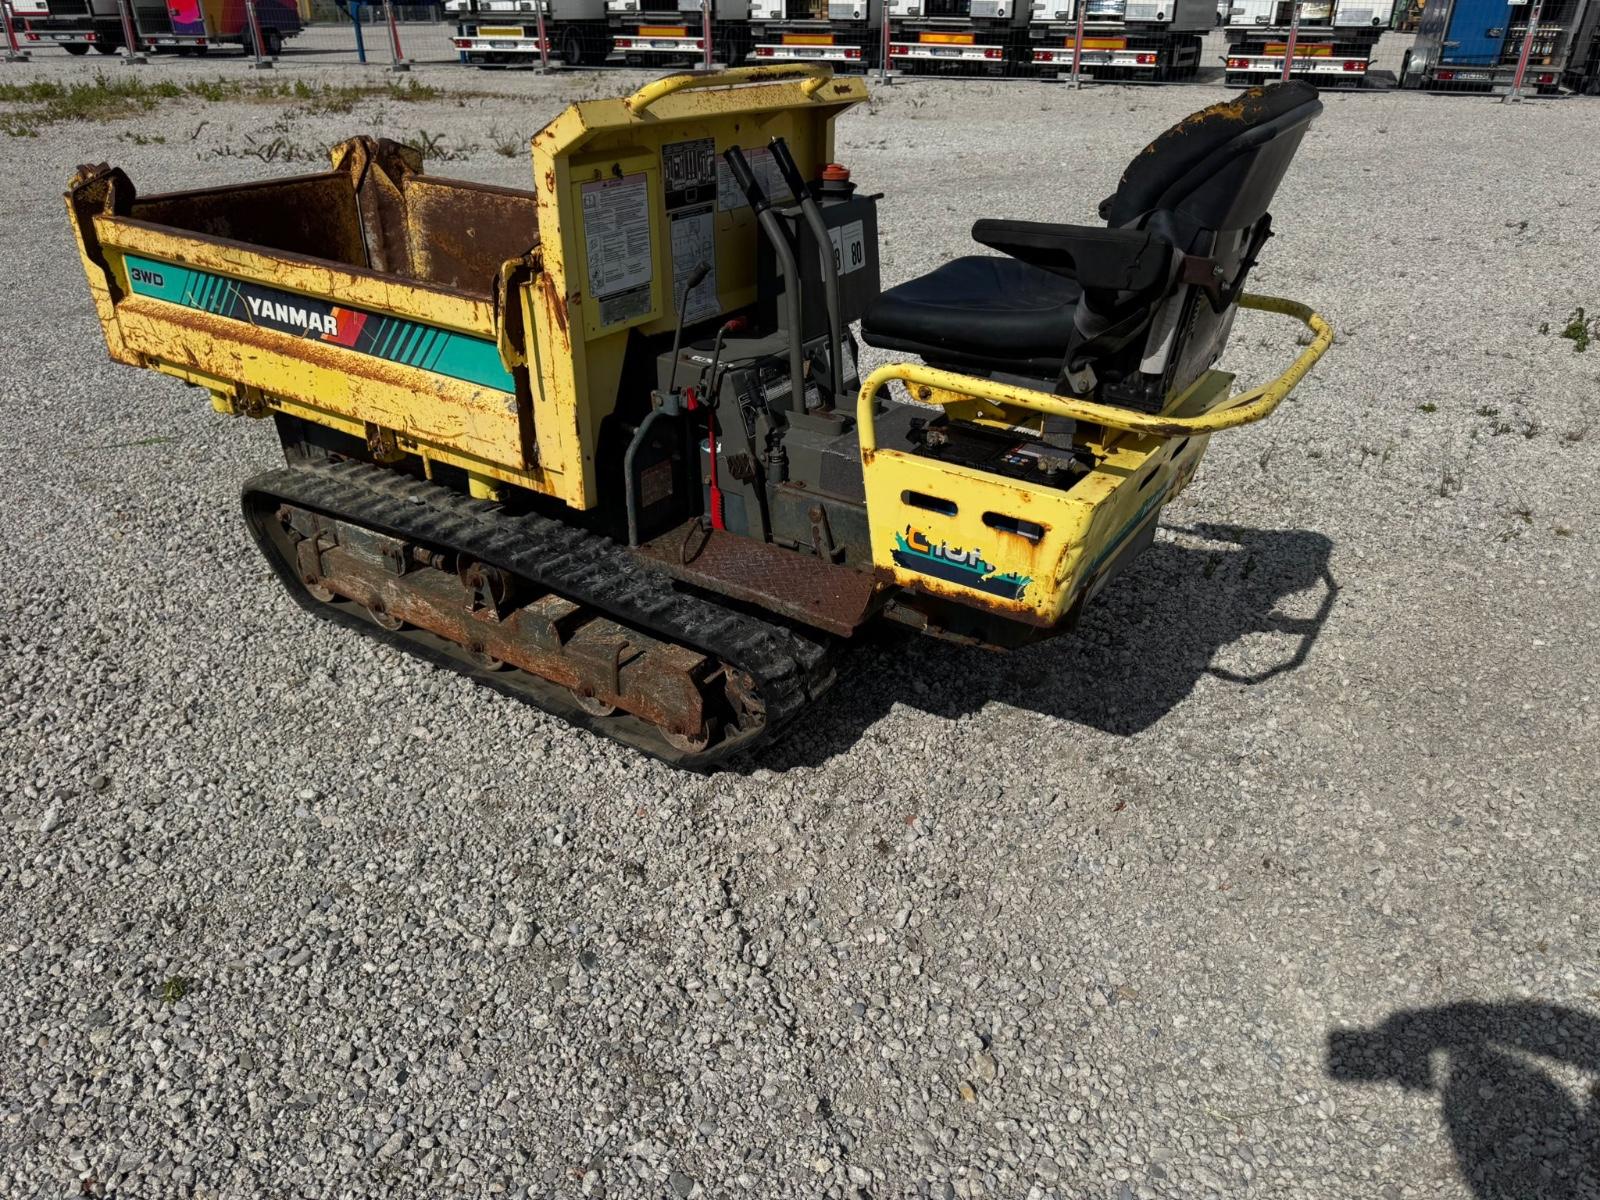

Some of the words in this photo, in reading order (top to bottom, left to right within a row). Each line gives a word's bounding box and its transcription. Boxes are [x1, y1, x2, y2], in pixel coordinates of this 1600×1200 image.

[851, 241, 862, 266] 80
[131, 268, 164, 286] 3WD
[247, 296, 338, 336] YANMAR
